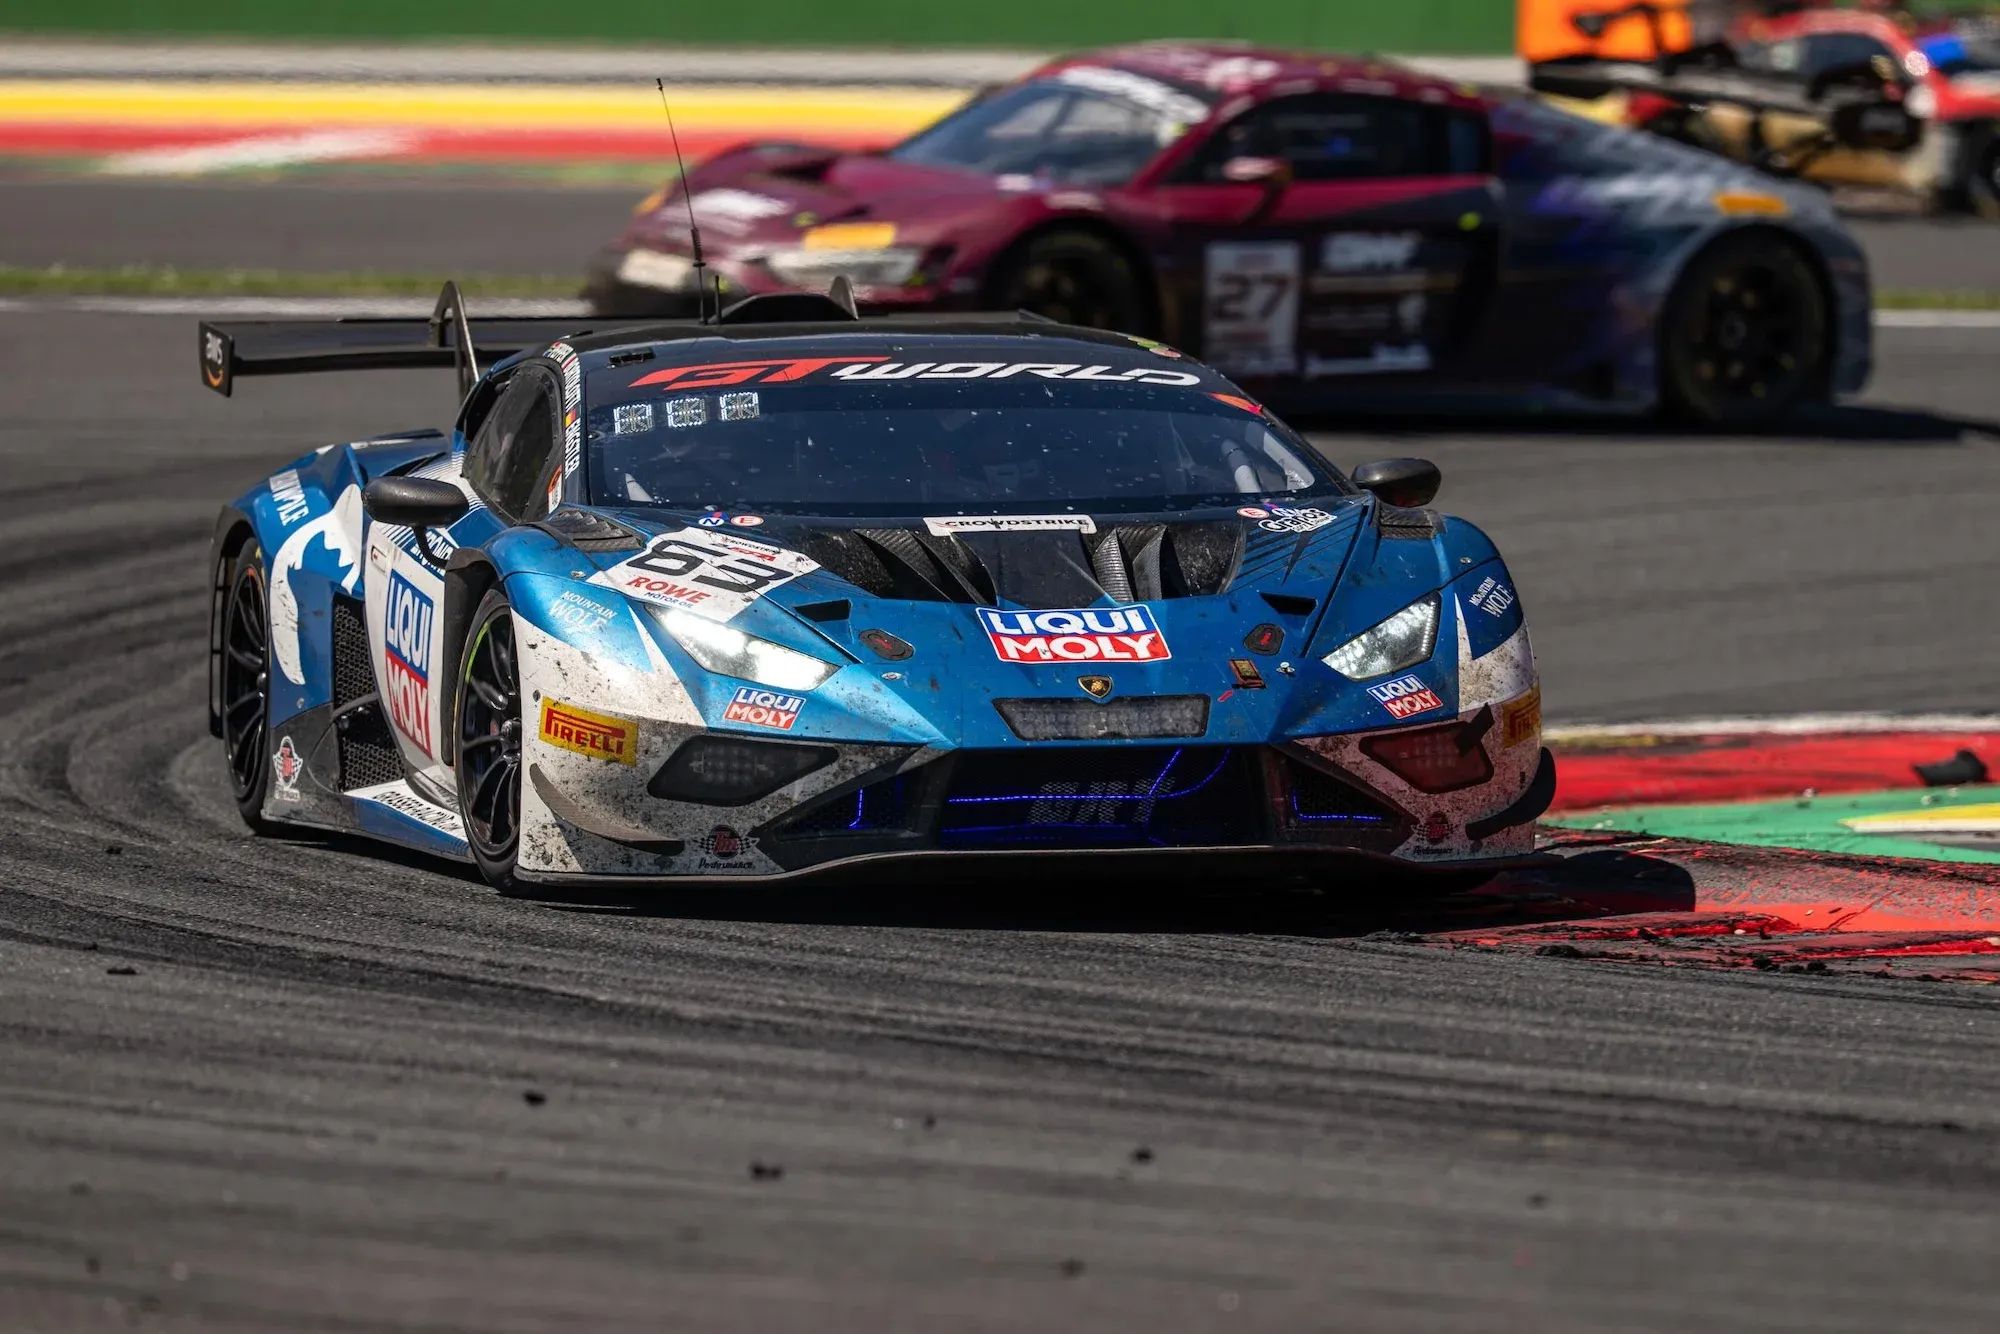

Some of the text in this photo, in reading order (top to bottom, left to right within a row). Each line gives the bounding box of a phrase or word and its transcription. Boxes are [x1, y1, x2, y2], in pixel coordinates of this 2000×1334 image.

[1214, 273, 1292, 321] 27
[831, 363, 1200, 386] WORLD
[945, 518, 1088, 527] CROWDSTRIKE
[626, 540, 795, 593] 63
[626, 576, 711, 603] ROWE
[644, 591, 678, 604] MOTOR
[1481, 584, 1513, 617] WOLF
[561, 591, 618, 619] MOUNTAIN
[387, 576, 432, 672] LIQUI
[986, 609, 1148, 634] LIQUI
[1000, 633, 1157, 660] MOLY
[735, 689, 802, 712] LIQUI
[1371, 676, 1425, 702] LIQUI
[387, 656, 428, 750] MOLY
[727, 704, 796, 727] MOLY
[1386, 690, 1437, 717] MOLY
[545, 707, 626, 755] PIRELLI
